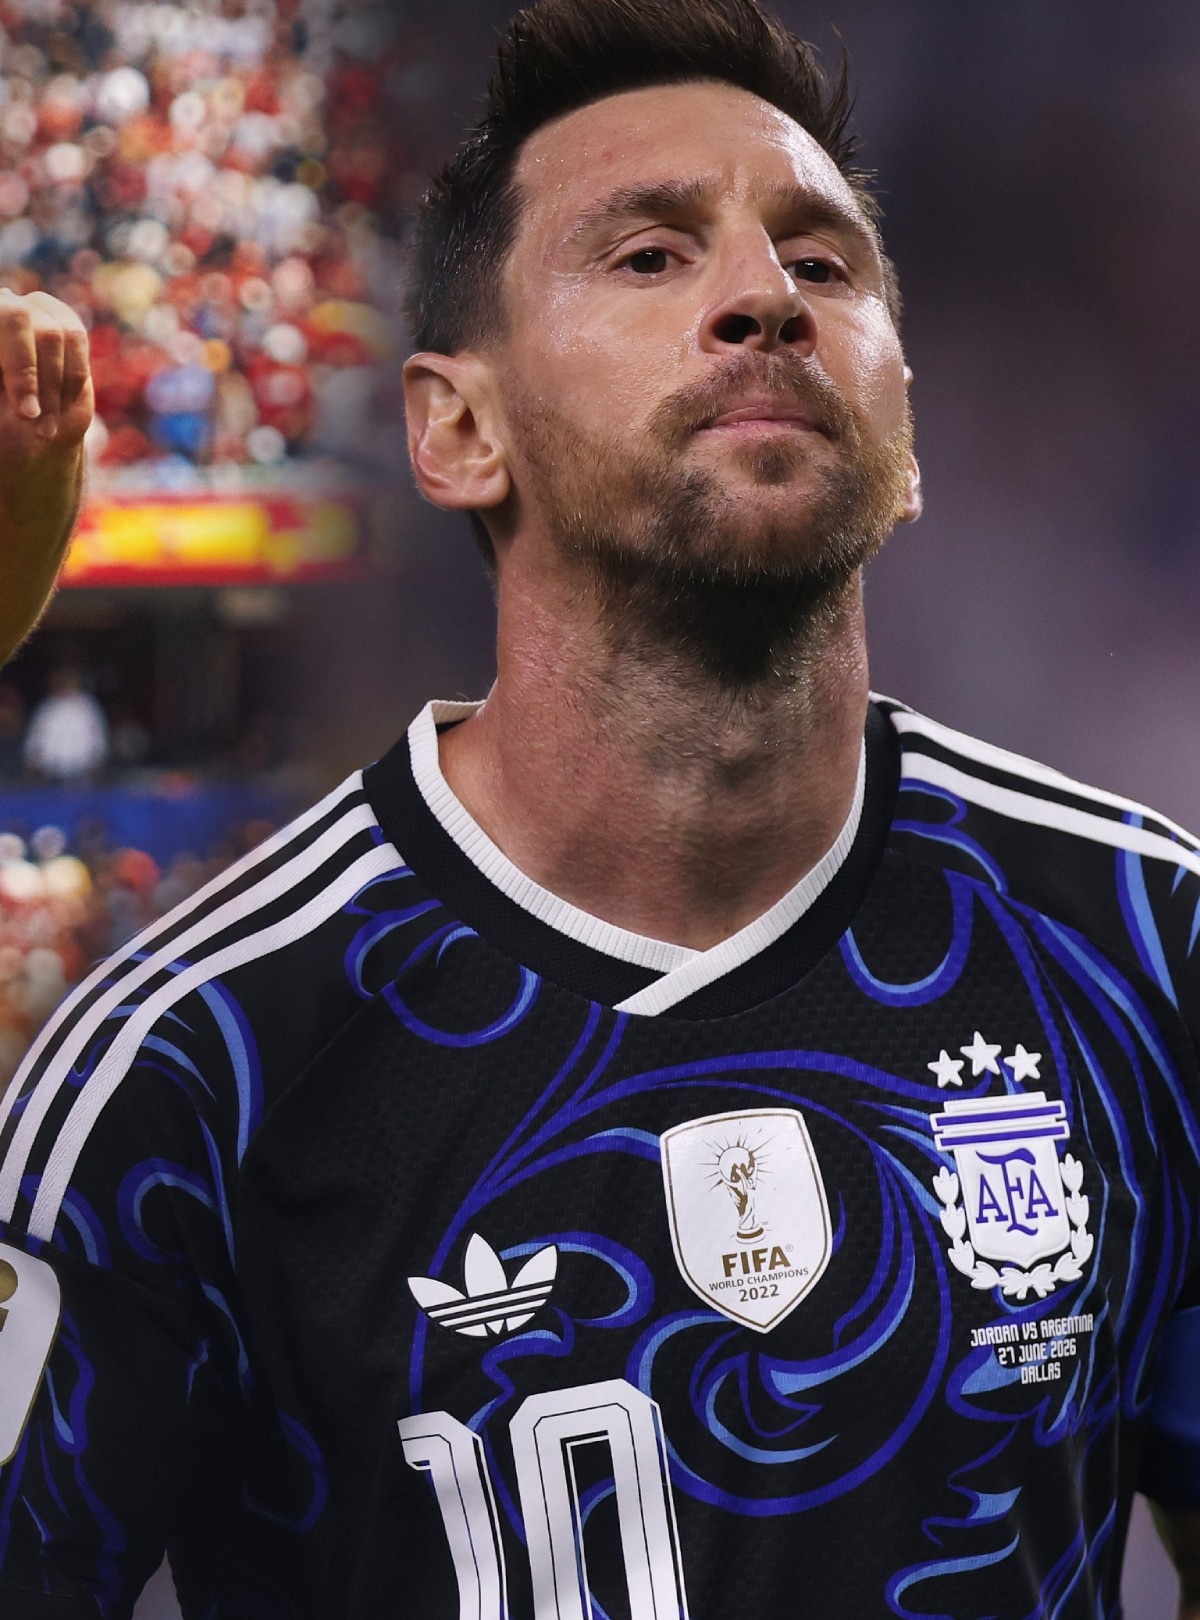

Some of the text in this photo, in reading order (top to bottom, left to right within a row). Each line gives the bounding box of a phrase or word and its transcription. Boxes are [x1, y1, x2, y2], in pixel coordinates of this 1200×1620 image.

[975, 1147, 1059, 1237] AFA
[709, 1267, 809, 1291] WORLD CHAMPIONS
[739, 1284, 779, 1302] 2022
[970, 1313, 1094, 1347] JORDAN VS ARGENTINA
[998, 1338, 1077, 1365] 27 JUNE 2026
[1021, 1362, 1061, 1384] DALLAS
[397, 1378, 689, 1620] 10
